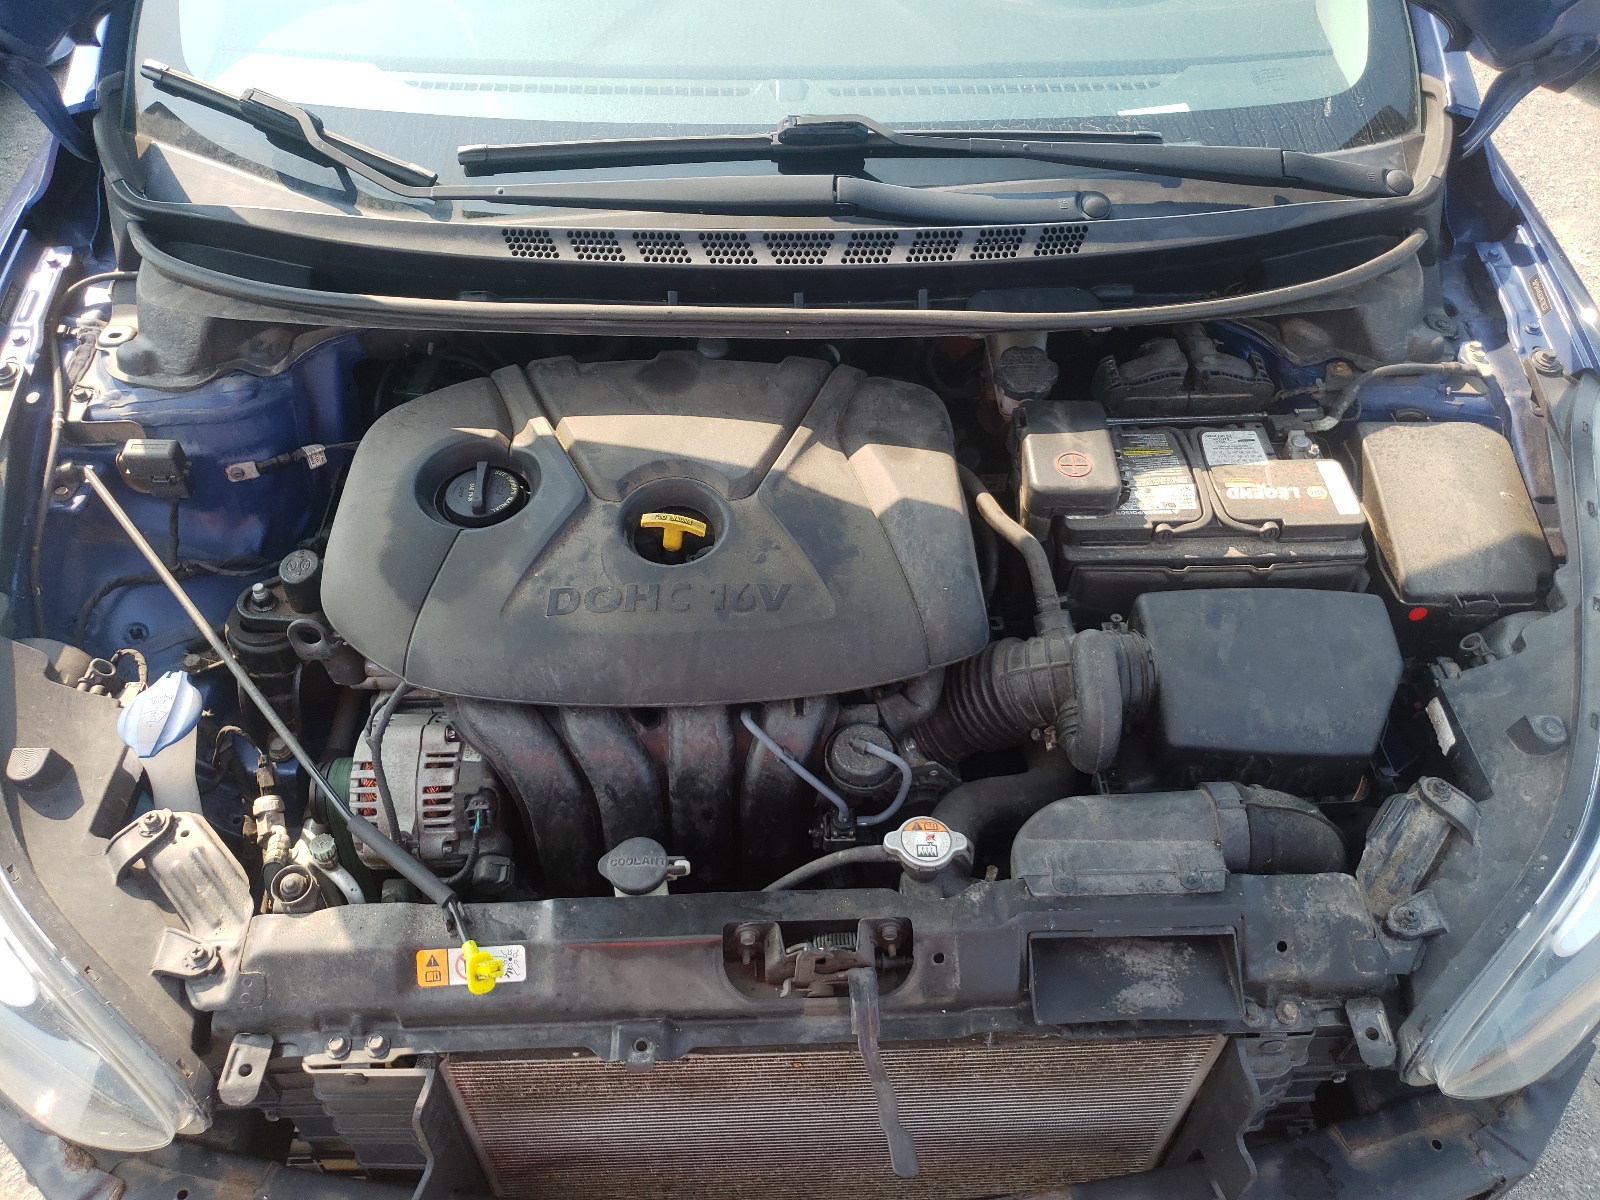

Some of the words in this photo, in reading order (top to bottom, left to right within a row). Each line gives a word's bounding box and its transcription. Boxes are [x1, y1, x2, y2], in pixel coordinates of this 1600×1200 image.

[1227, 488, 1301, 500] LEGEND
[546, 583, 693, 617] DOHC
[710, 583, 792, 613] 16V
[610, 857, 666, 867] COOLANT
